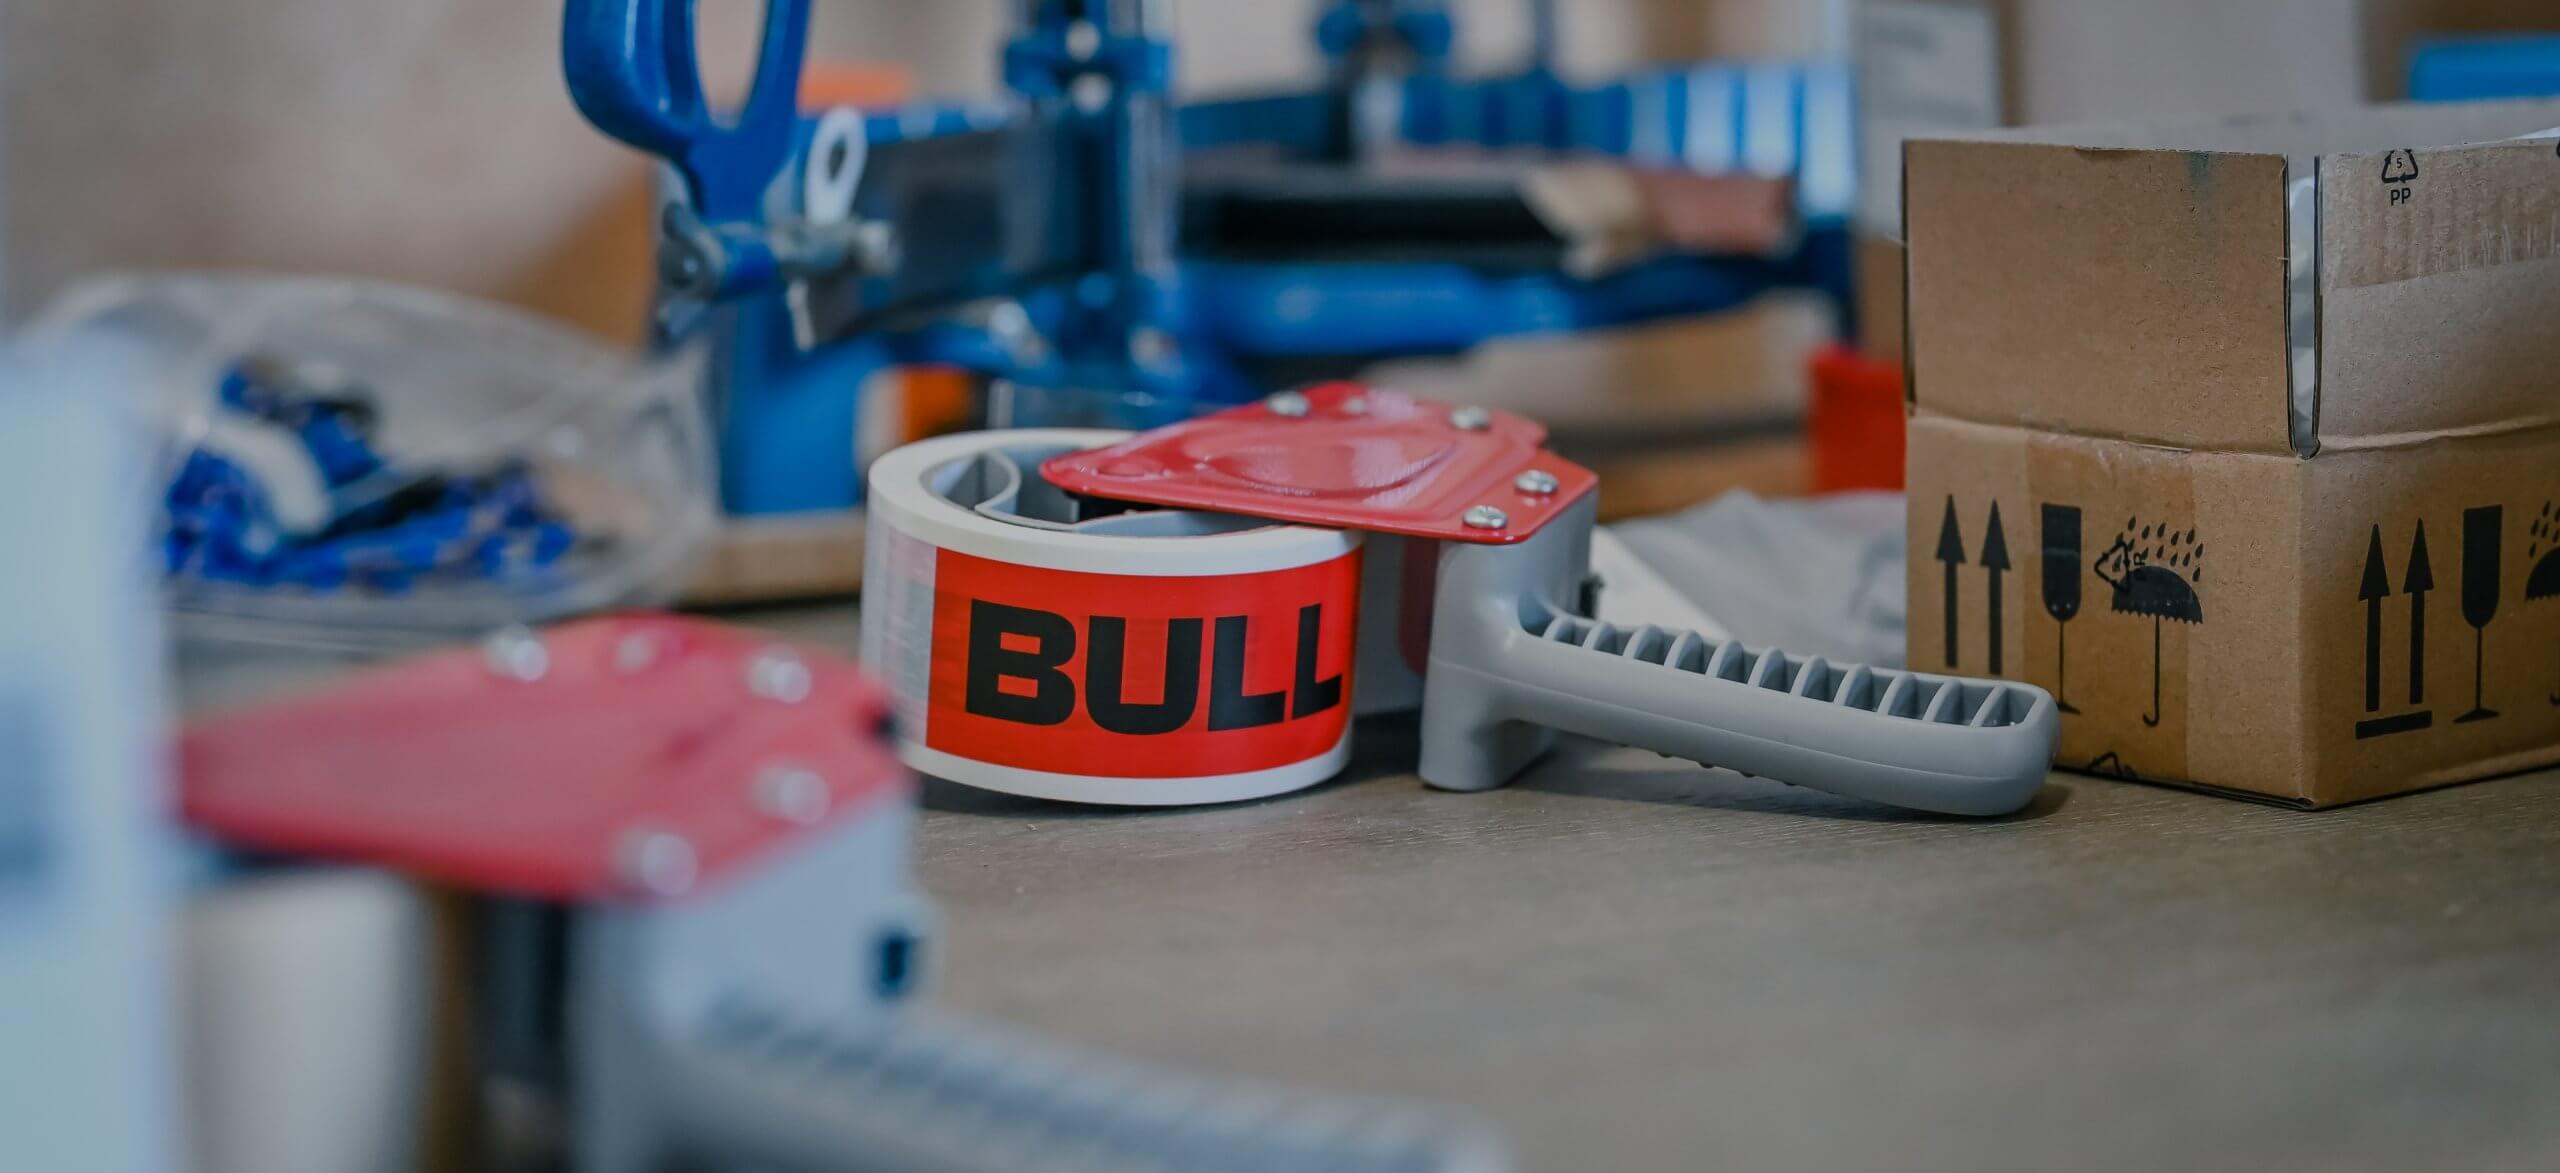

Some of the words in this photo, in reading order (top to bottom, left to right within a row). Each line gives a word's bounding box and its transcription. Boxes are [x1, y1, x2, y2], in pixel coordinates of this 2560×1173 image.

[2396, 157, 2403, 169] 5
[2390, 187, 2411, 206] PP
[965, 598, 1342, 735] BULL
